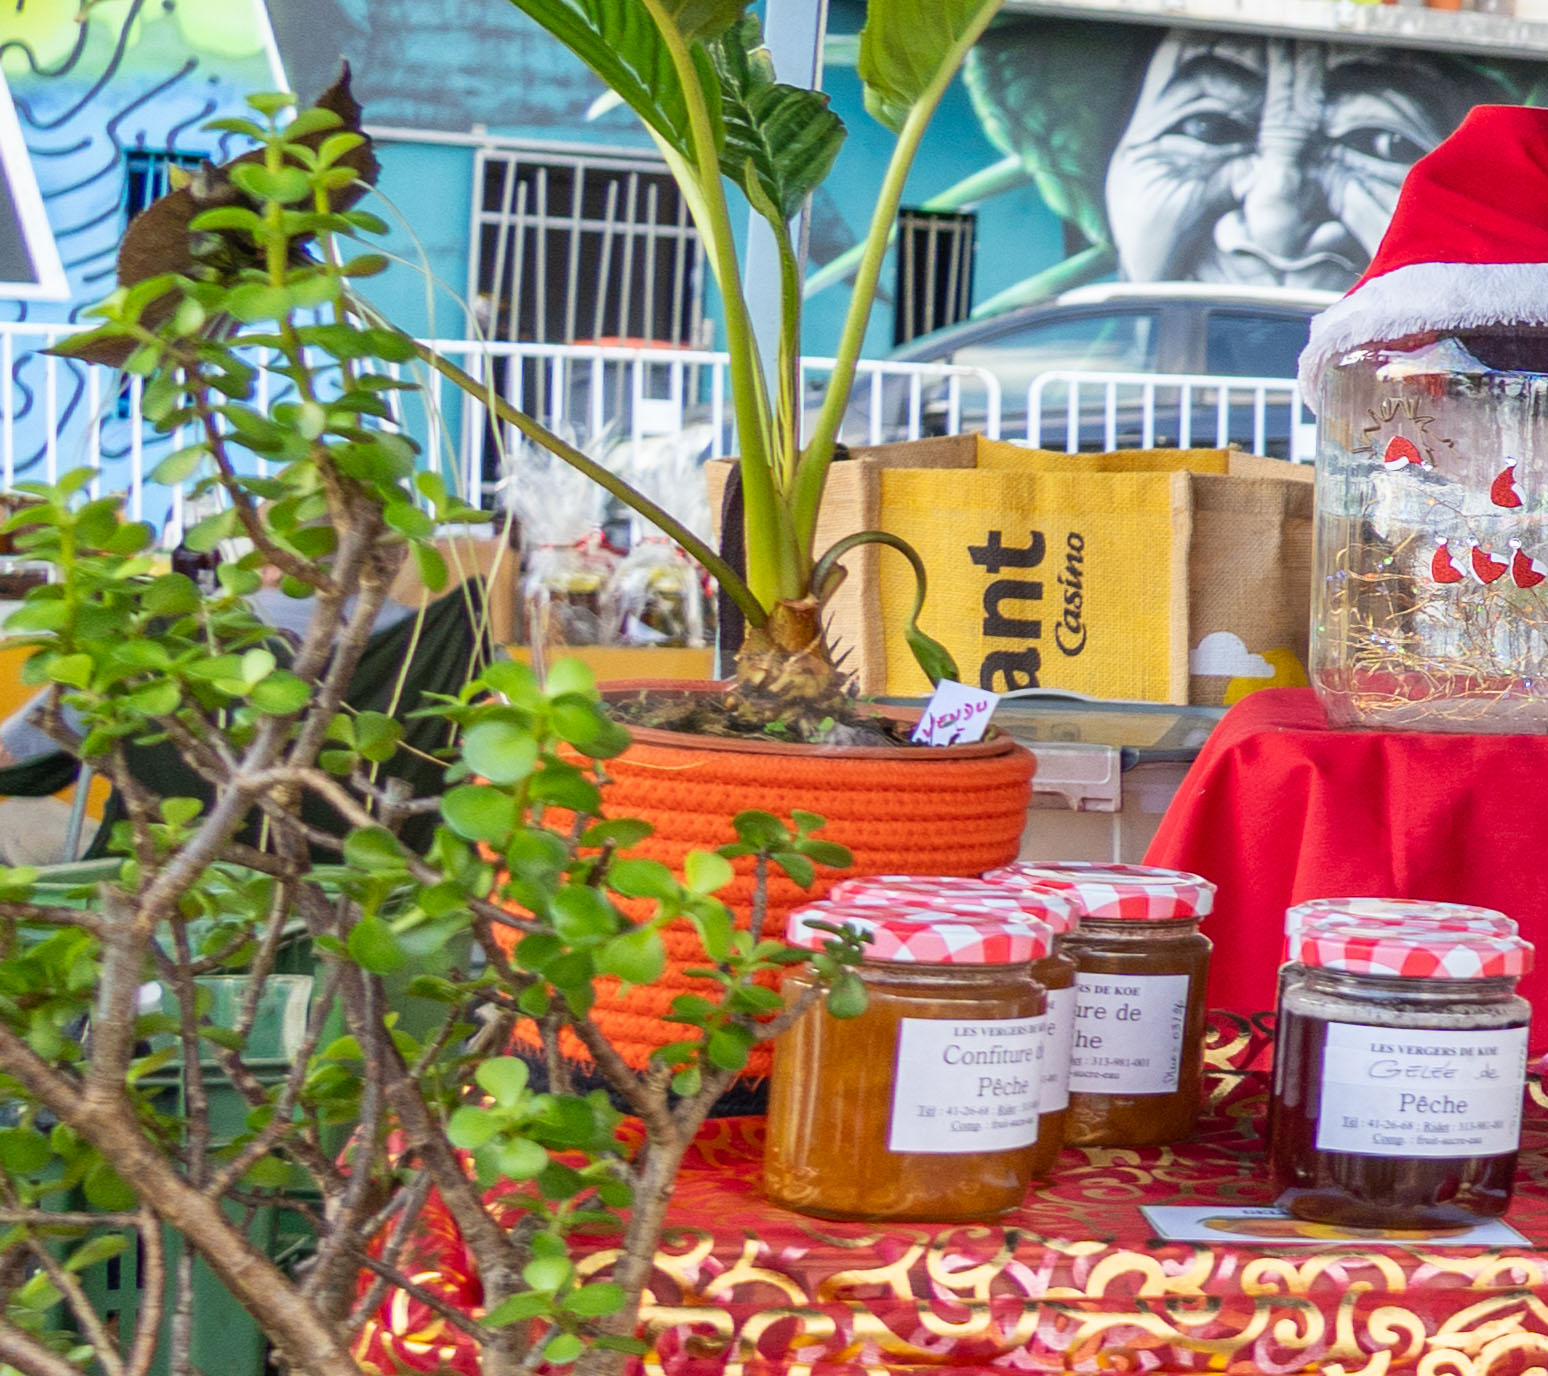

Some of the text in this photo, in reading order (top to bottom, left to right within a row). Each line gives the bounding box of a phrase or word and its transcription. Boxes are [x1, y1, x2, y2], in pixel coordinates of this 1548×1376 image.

[1055, 532, 1087, 657] Casino
[1094, 985, 1141, 996] DE KOE
[1116, 1003, 1141, 1021] de
[954, 1027, 977, 1037] LES
[943, 1044, 1033, 1065] Confiture
[1371, 1043, 1498, 1056] LES VERGERS DE KOE
[976, 1075, 1029, 1097] Pêche
[1398, 1093, 1468, 1114] Pêche
